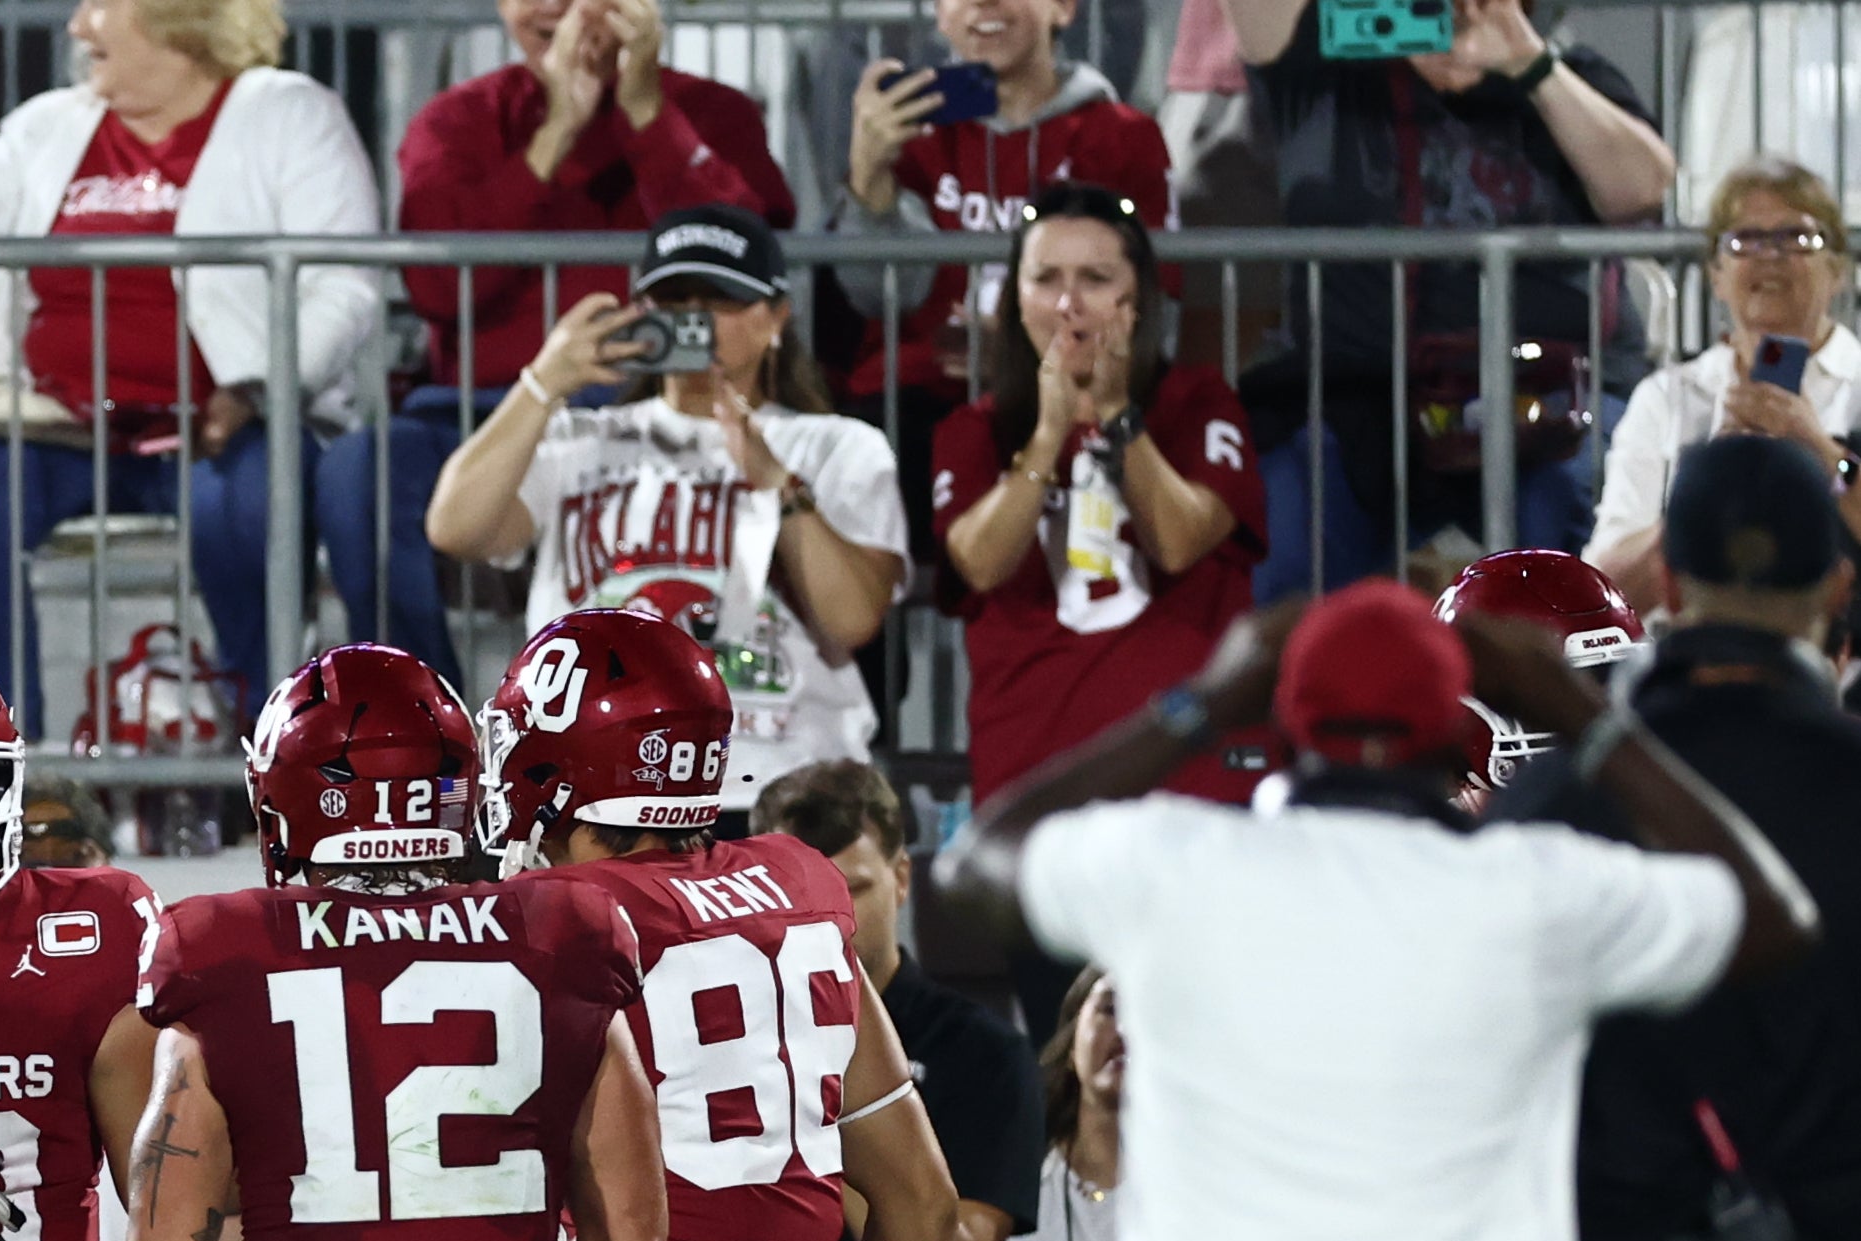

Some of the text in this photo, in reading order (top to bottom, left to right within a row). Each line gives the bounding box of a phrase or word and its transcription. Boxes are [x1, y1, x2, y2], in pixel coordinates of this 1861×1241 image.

[522, 637, 588, 733] OU
[641, 737, 666, 762] SEC
[669, 740, 722, 781] 86
[321, 790, 346, 816] SEC
[374, 779, 433, 824] 12
[343, 838, 450, 859] SOONERS
[669, 864, 793, 923] KENT
[42, 914, 97, 954] C
[296, 895, 509, 950] KANAK
[642, 921, 856, 1191] 86
[266, 960, 547, 1223] 12
